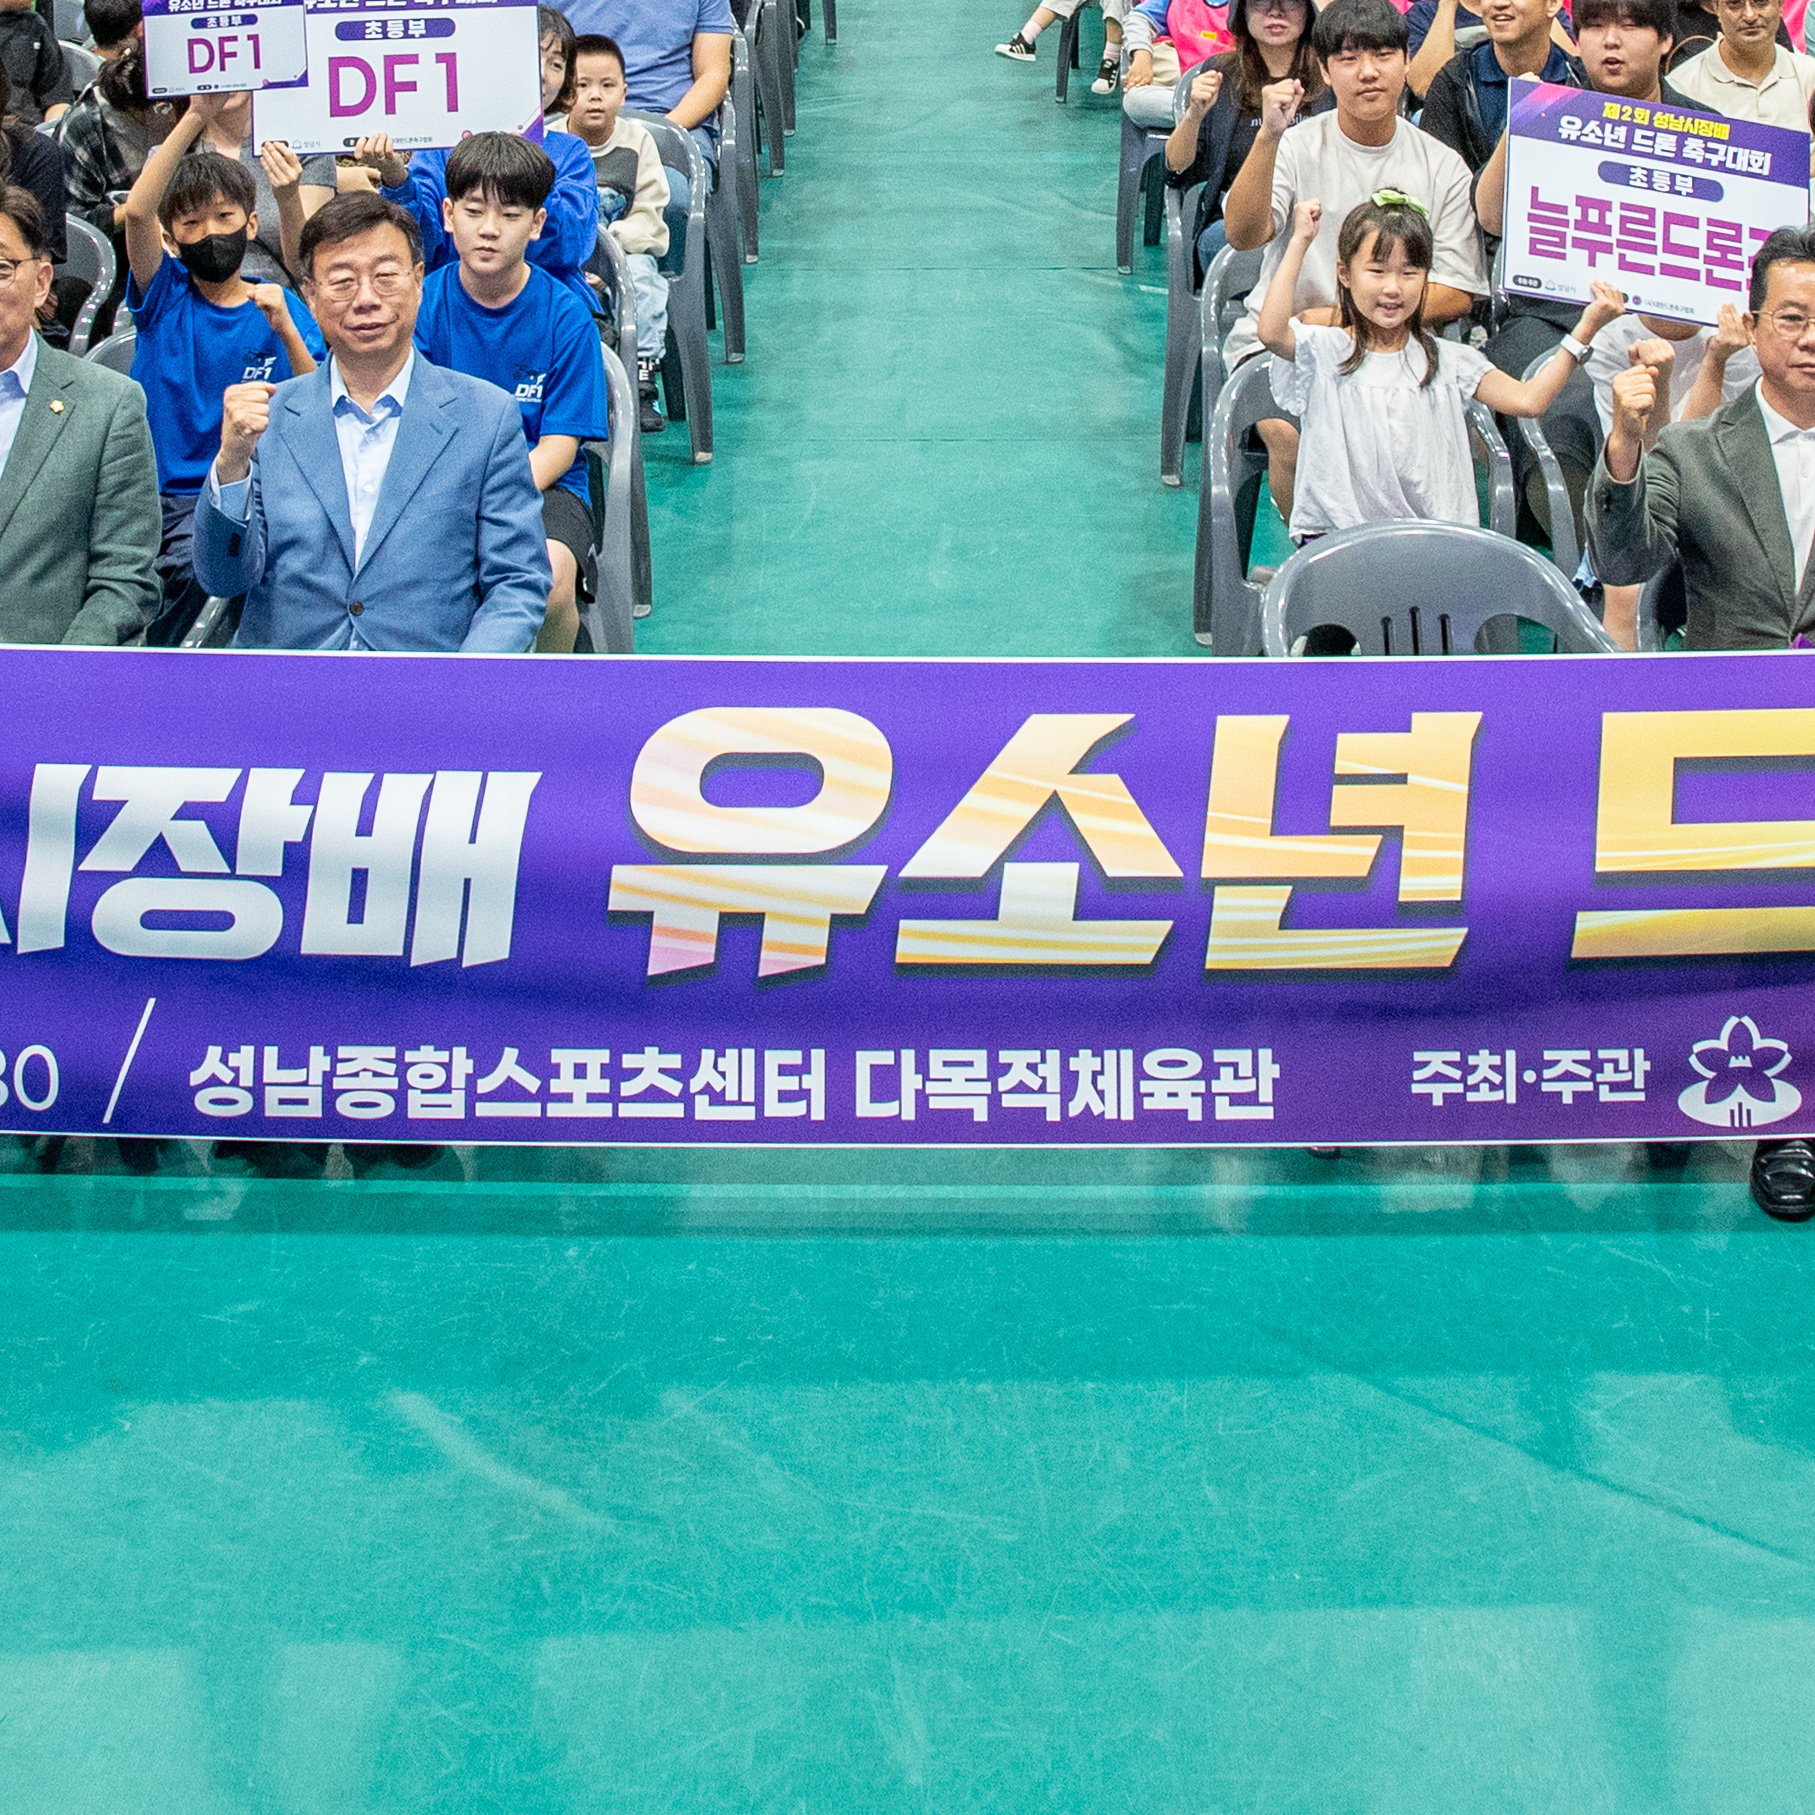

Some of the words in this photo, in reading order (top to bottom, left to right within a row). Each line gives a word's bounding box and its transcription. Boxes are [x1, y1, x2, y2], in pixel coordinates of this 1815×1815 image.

[187, 33, 262, 74] DF1
[365, 19, 427, 38] 초등부
[328, 52, 459, 117] DF1
[1558, 114, 1627, 149] 유소년
[1631, 127, 1678, 158] 드론
[1682, 136, 1772, 177] 축구대회
[1602, 102, 1650, 126] 제2회
[1653, 110, 1731, 141] 성남시장배
[1630, 166, 1694, 197] 초등부
[606, 706, 1486, 982] 유소년
[189, 1044, 829, 1119] 성남종합스포츠센터
[854, 1045, 1282, 1123] 다목적체육관
